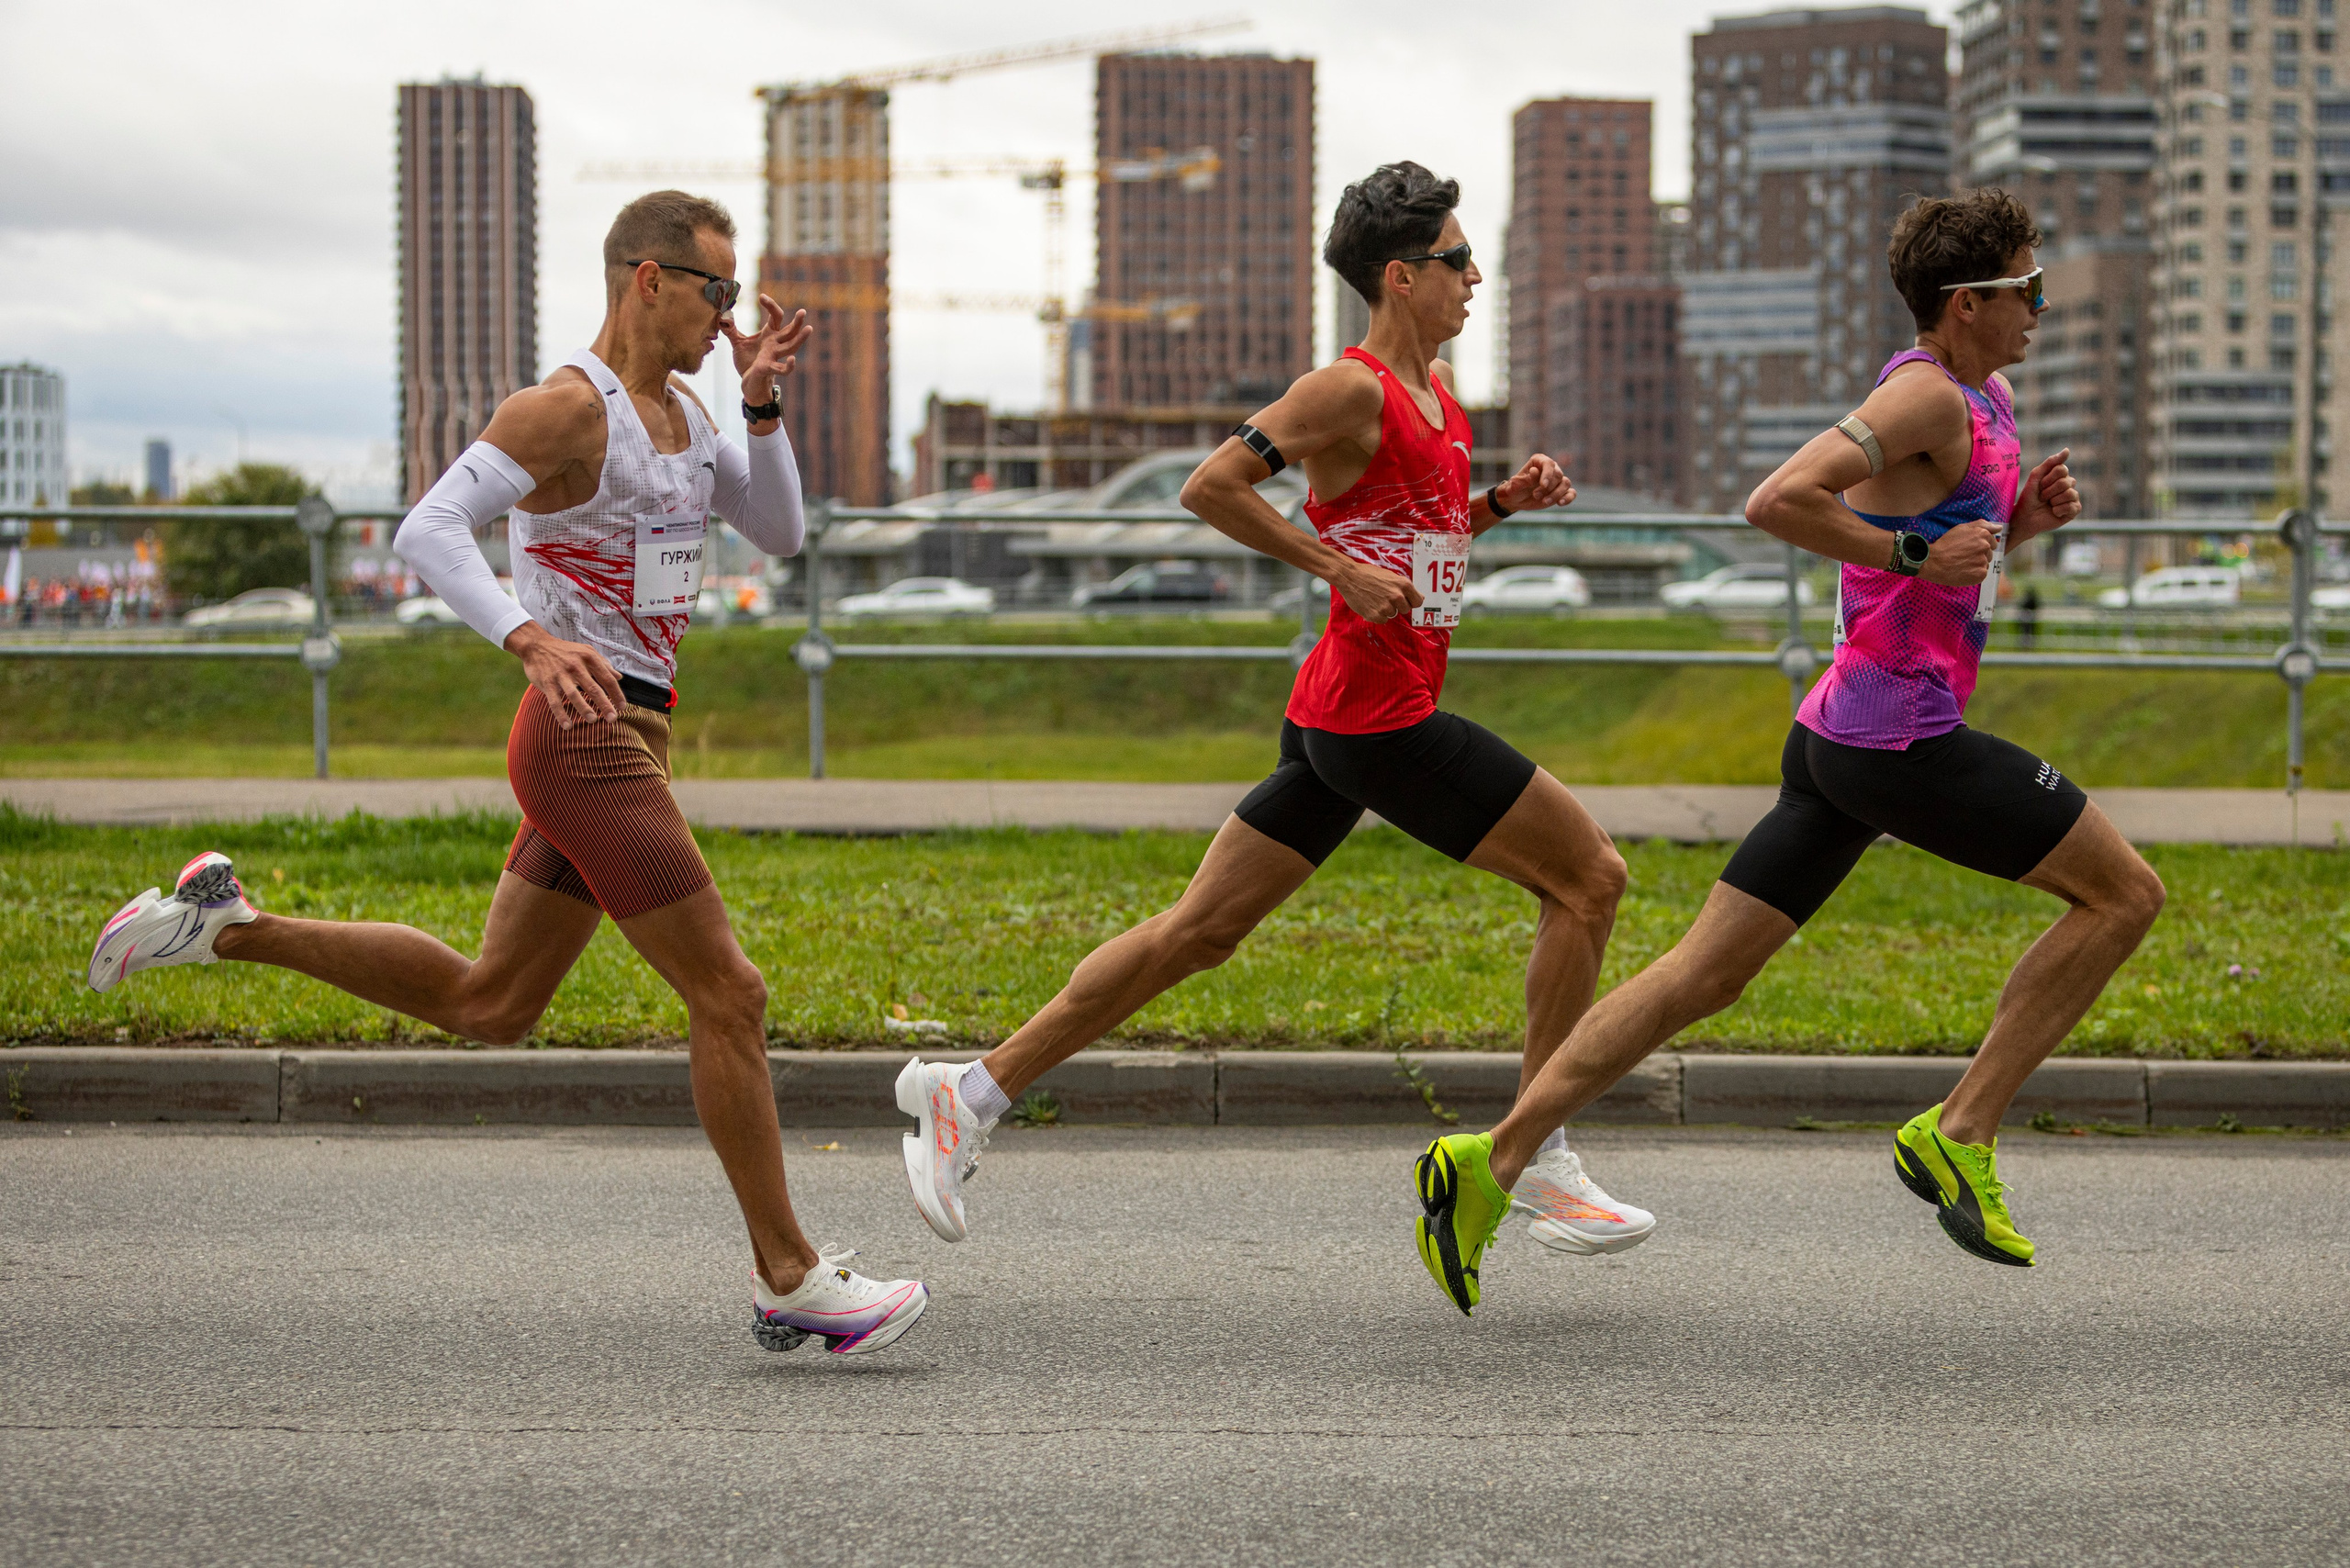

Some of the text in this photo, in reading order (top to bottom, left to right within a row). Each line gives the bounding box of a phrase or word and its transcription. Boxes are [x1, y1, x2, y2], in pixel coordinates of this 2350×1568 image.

[661, 543, 703, 566] ГУРЖИЙ
[684, 571, 688, 582] 2
[1427, 561, 1465, 593] 152
[2035, 759, 2051, 786] HUA
